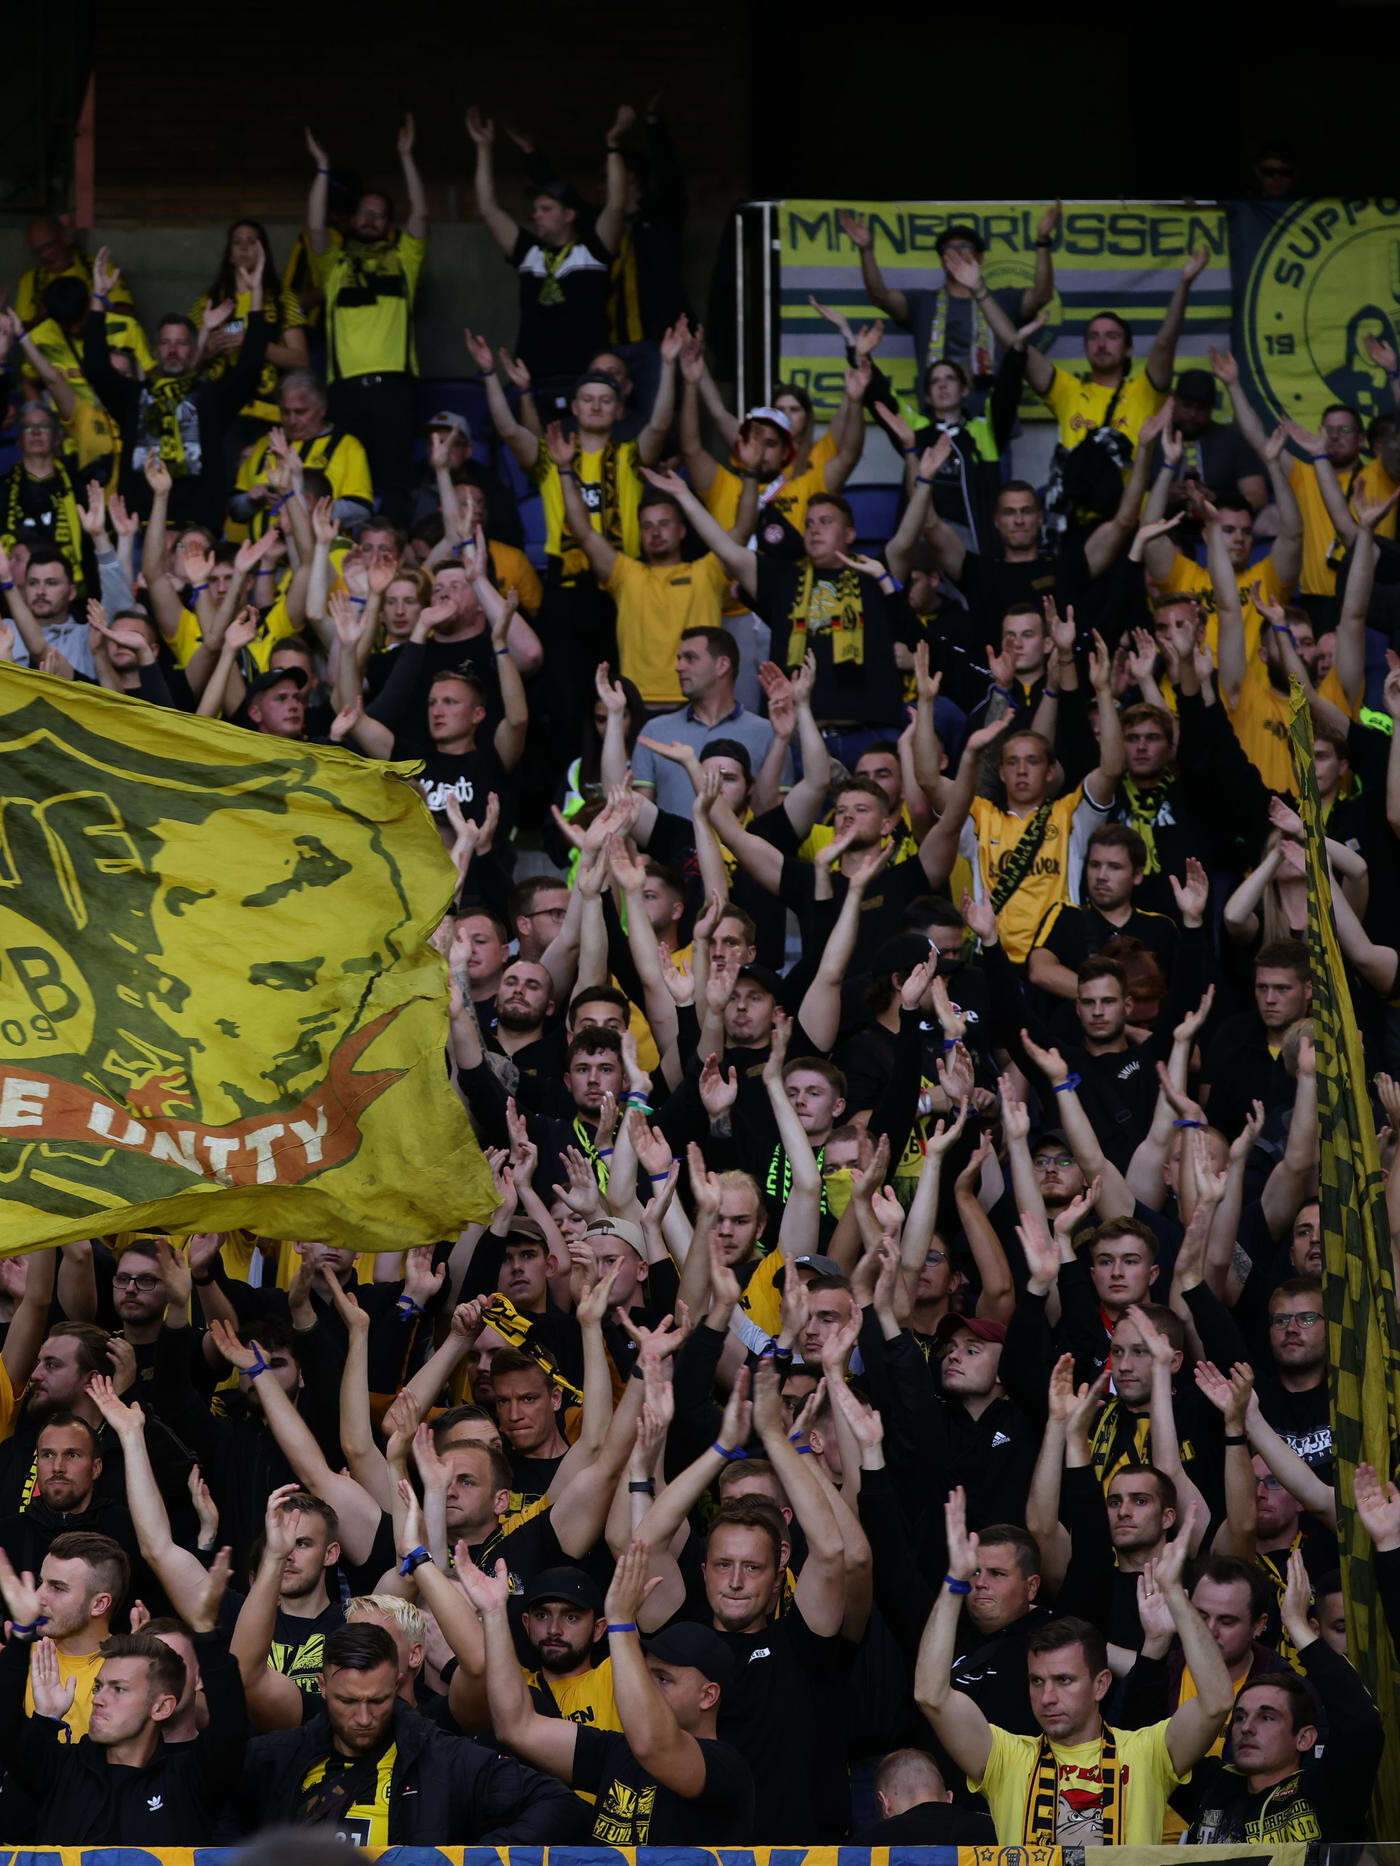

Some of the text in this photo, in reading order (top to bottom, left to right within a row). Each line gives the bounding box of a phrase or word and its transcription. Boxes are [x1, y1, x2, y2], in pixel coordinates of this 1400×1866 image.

[789, 209, 1228, 257] MANBRUSSEN
[0, 1013, 59, 1047] 09
[86, 1100, 328, 1190] UNITY
